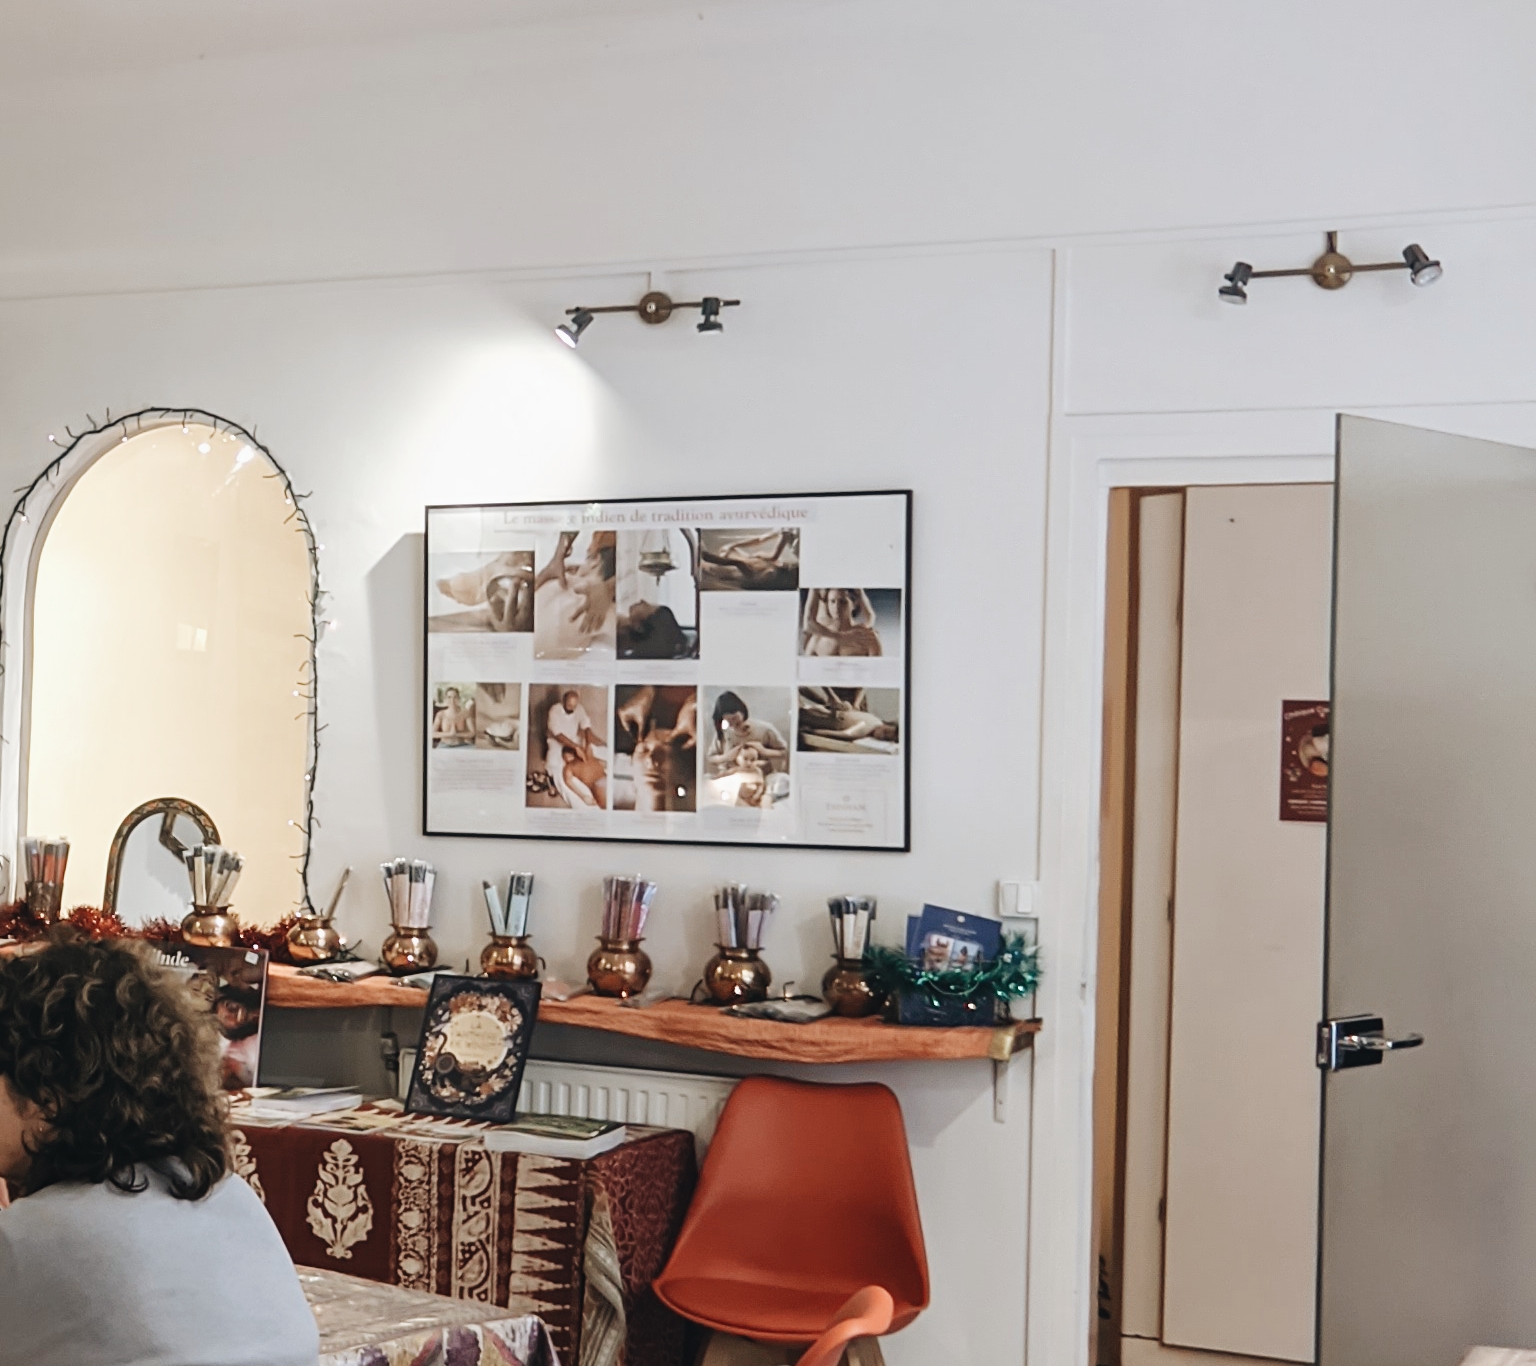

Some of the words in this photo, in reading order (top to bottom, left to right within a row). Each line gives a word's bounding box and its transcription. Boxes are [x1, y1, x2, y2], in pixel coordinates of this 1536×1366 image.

[503, 510, 519, 524] Le
[523, 514, 576, 526] massge
[630, 509, 647, 522] de
[651, 508, 714, 522] tradition
